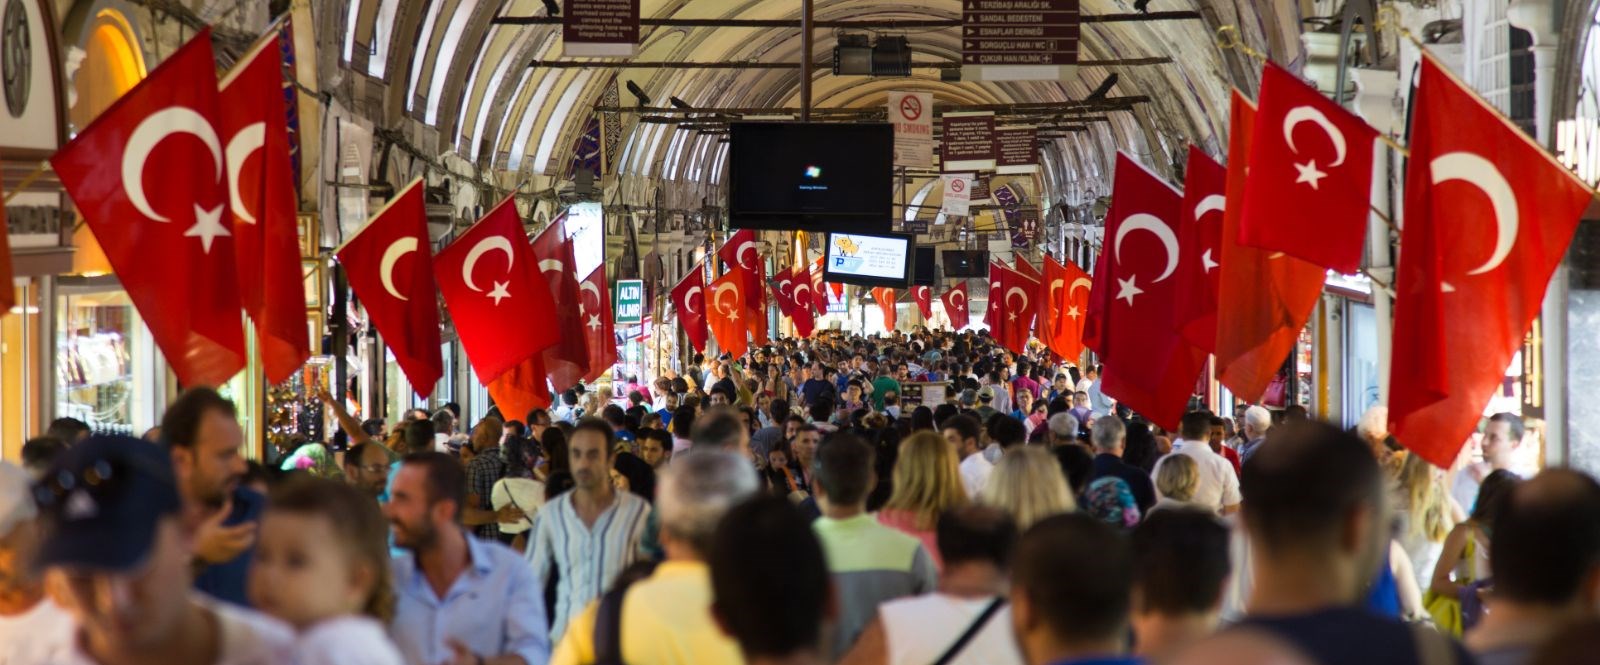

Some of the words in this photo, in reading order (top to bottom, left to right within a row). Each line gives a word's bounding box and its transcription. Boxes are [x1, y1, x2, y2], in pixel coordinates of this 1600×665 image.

[980, 14, 1005, 22] SANDAL
[903, 123, 930, 134] SMOKING
[620, 286, 640, 300] ALTIN
[618, 304, 640, 317] ALINIR
